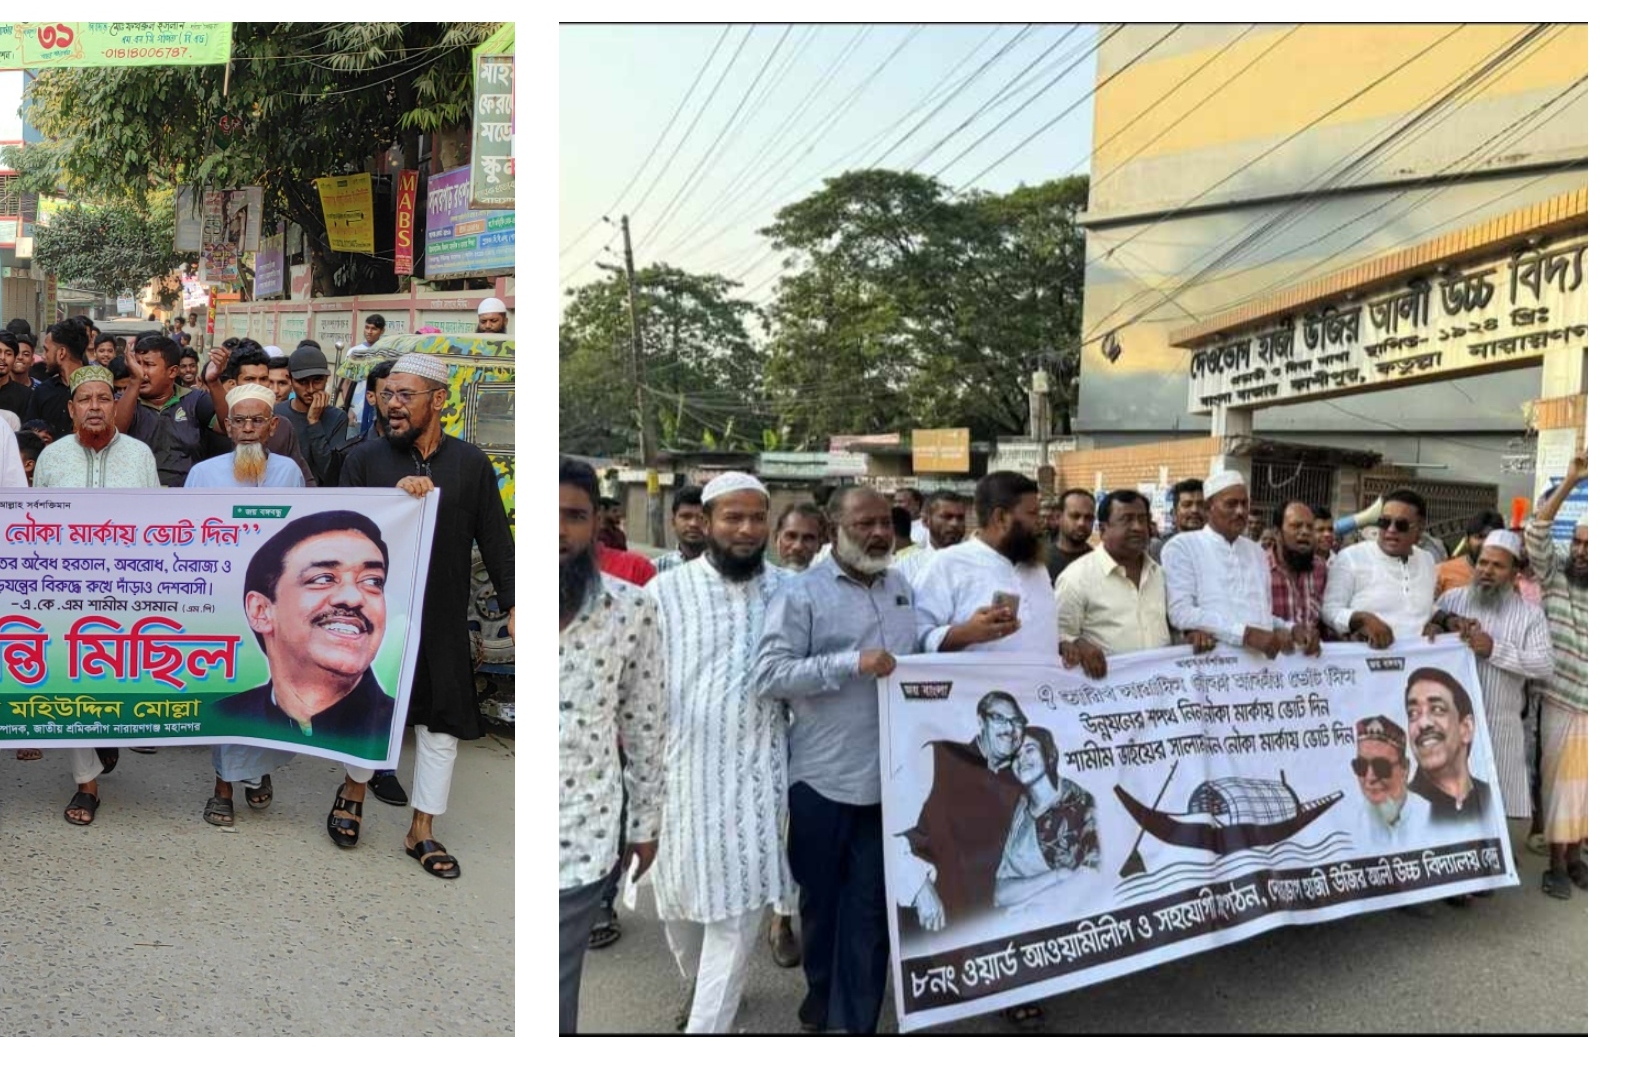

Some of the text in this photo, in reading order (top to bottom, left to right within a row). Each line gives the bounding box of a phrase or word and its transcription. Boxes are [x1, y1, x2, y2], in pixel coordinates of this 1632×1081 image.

[1303, 306, 1362, 351] উজির
[1368, 278, 1432, 335] আলী
[1439, 268, 1498, 317] উচ্চ
[26, 499, 72, 510] সর্বশক্তিমান
[5, 512, 63, 543] নৌকা
[68, 518, 138, 546] মার্কায়
[143, 518, 195, 546] ভোট
[21, 551, 58, 571] অবৈধ
[61, 557, 111, 573] হরতাল,
[114, 557, 168, 574] অবরোধ,
[172, 553, 219, 573] নৈরাজ্য
[221, 559, 232, 573] ও
[42, 575, 82, 595] বিরুদ্ধে
[86, 580, 113, 595] রুখে
[116, 577, 153, 595] দাঁড়াও
[157, 577, 214, 596] দেশবাসী।
[88, 596, 179, 613] শামীম ওসমান
[64, 615, 244, 691] মিছিল
[8, 696, 123, 720] মহিউদ্দিন
[133, 697, 202, 719] মোল্লা
[1079, 692, 1331, 742] উন্নয়নের শপথ মার্কায় ভোট দিন
[33, 721, 64, 736] জাতীয়
[66, 720, 111, 736] শ্রমিকলীগ
[163, 720, 202, 734] মহানগর
[1065, 720, 1356, 772] শামীম নৌকা মার্কায় ভোট দিন
[910, 963, 960, 998] ৮নং
[961, 942, 1019, 987] ওয়ার্ড
[1020, 912, 1136, 969] আওয়ামীলীগ
[1137, 917, 1153, 940] ও
[1422, 848, 1481, 879] বিদ্যালয়
